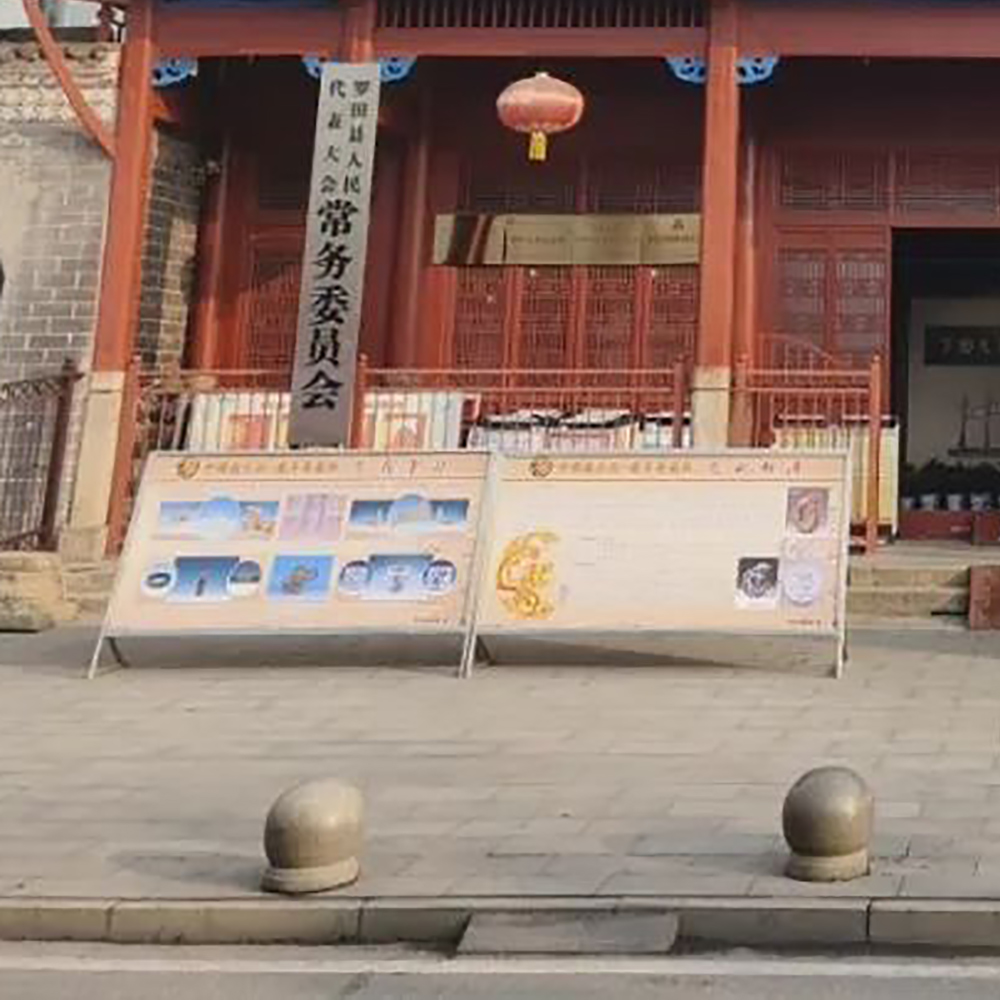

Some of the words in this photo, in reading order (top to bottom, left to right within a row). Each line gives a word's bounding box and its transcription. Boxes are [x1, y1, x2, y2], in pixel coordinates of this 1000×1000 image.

[319, 79, 346, 194] 代表大会
[343, 79, 371, 195] 罗田县人民
[301, 199, 358, 411] 常务委员会
